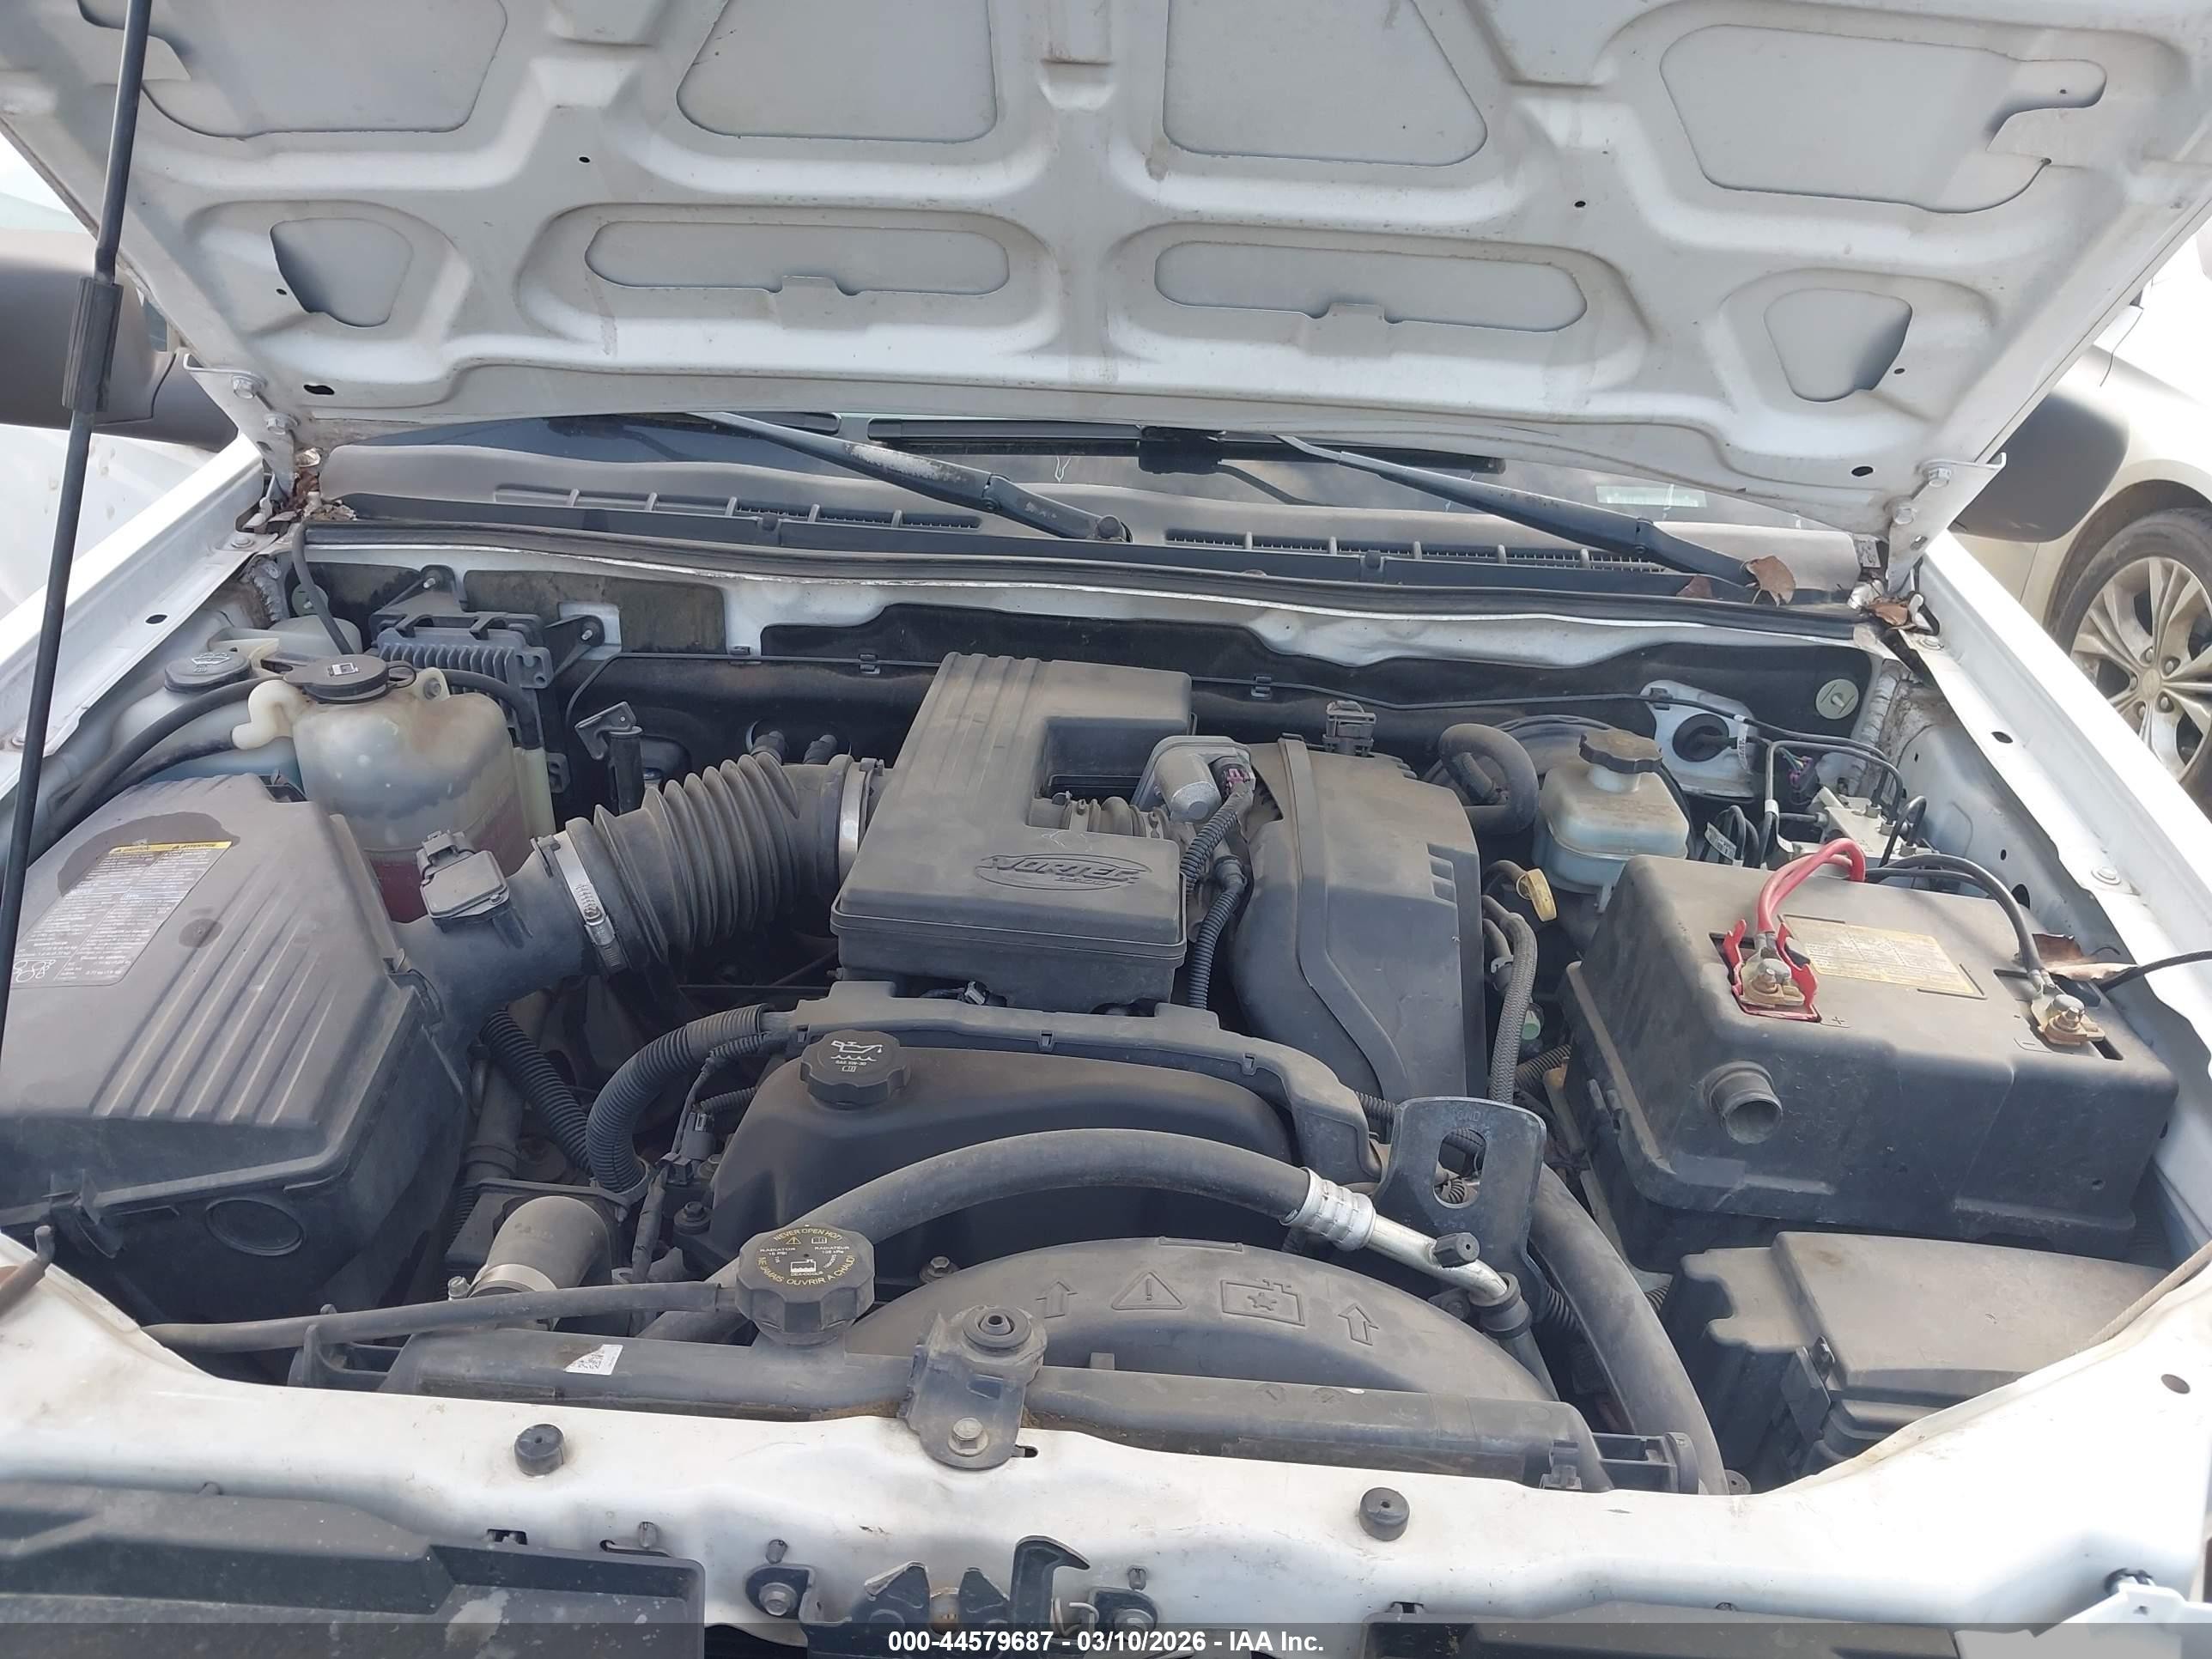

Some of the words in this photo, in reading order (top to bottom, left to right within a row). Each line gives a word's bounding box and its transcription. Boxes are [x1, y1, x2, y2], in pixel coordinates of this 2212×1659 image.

[991, 857, 1141, 884] VORTEC
[774, 1229, 800, 1241] NEVER
[757, 1256, 767, 1266] NE
[834, 1254, 855, 1276] CHAUD
[760, 1266, 785, 1282] JAMAIS
